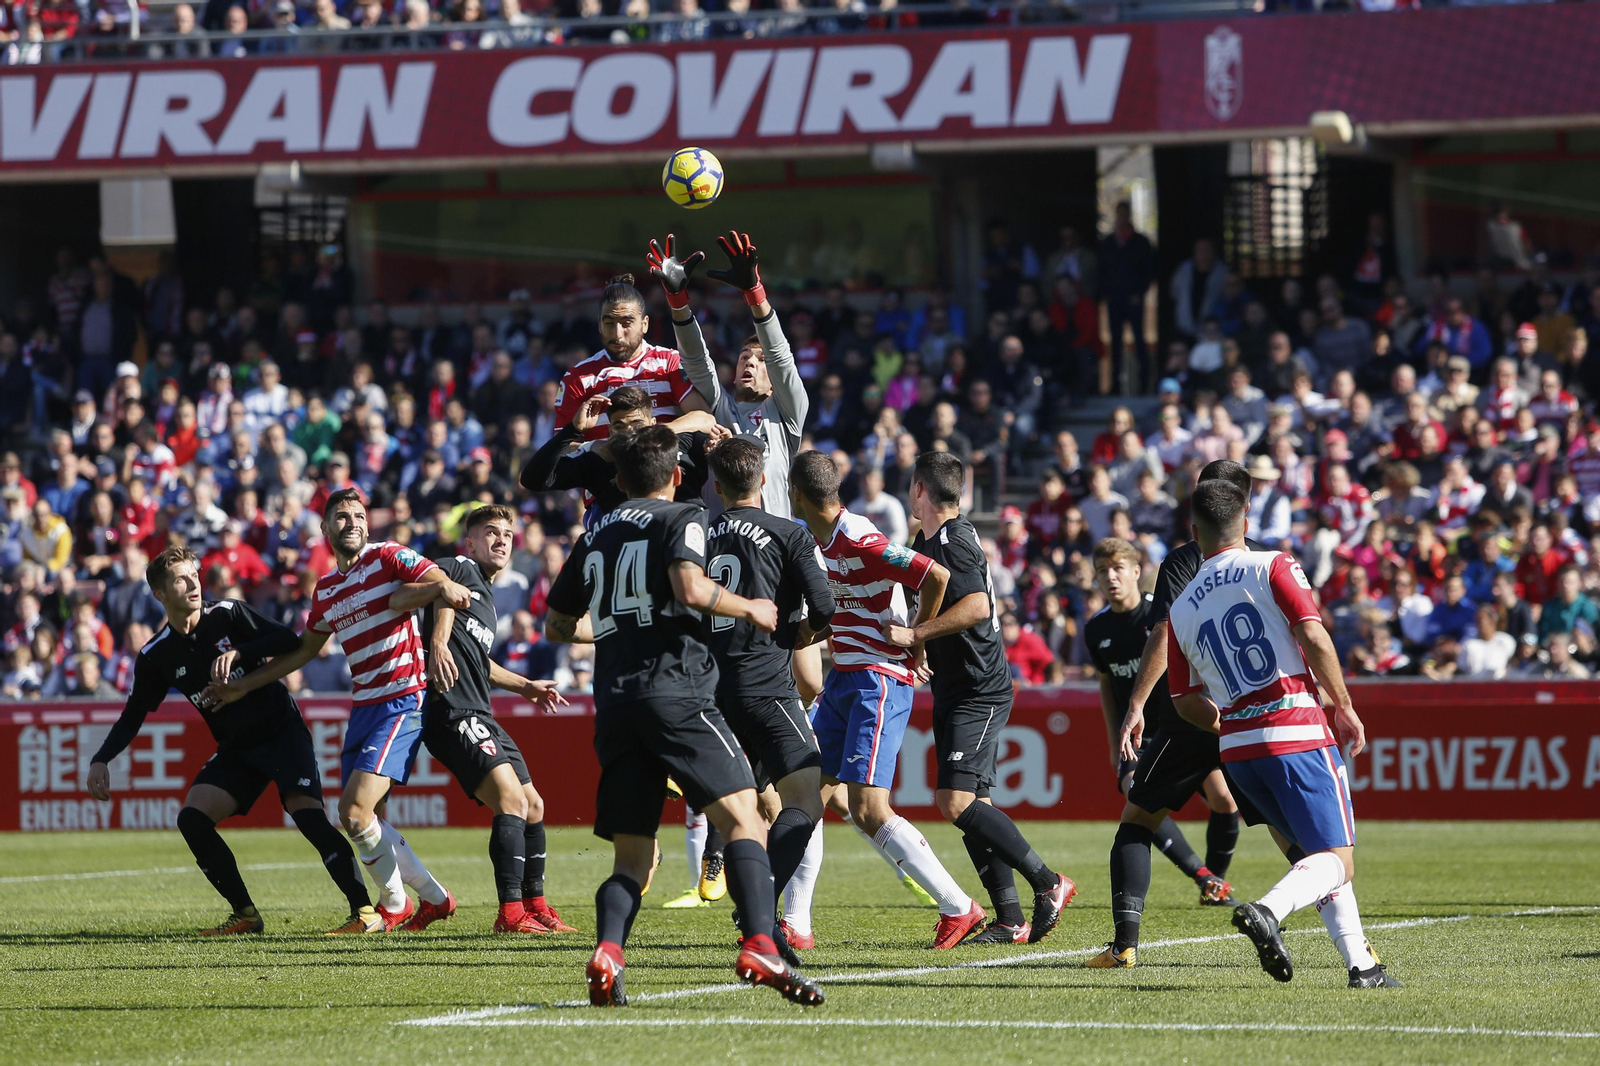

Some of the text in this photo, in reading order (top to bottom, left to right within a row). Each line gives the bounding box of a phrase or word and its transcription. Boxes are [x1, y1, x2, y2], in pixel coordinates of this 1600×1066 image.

[488, 33, 1131, 148] COVIRAN
[584, 508, 653, 548] CARBALLO
[583, 539, 653, 641] 24
[1187, 567, 1246, 611] JOSELU
[354, 609, 370, 622] KING
[1197, 601, 1278, 701] 18
[458, 716, 491, 745] 16
[1345, 736, 1570, 791] CERVEZAS
[20, 796, 183, 831] ENERGY KING
